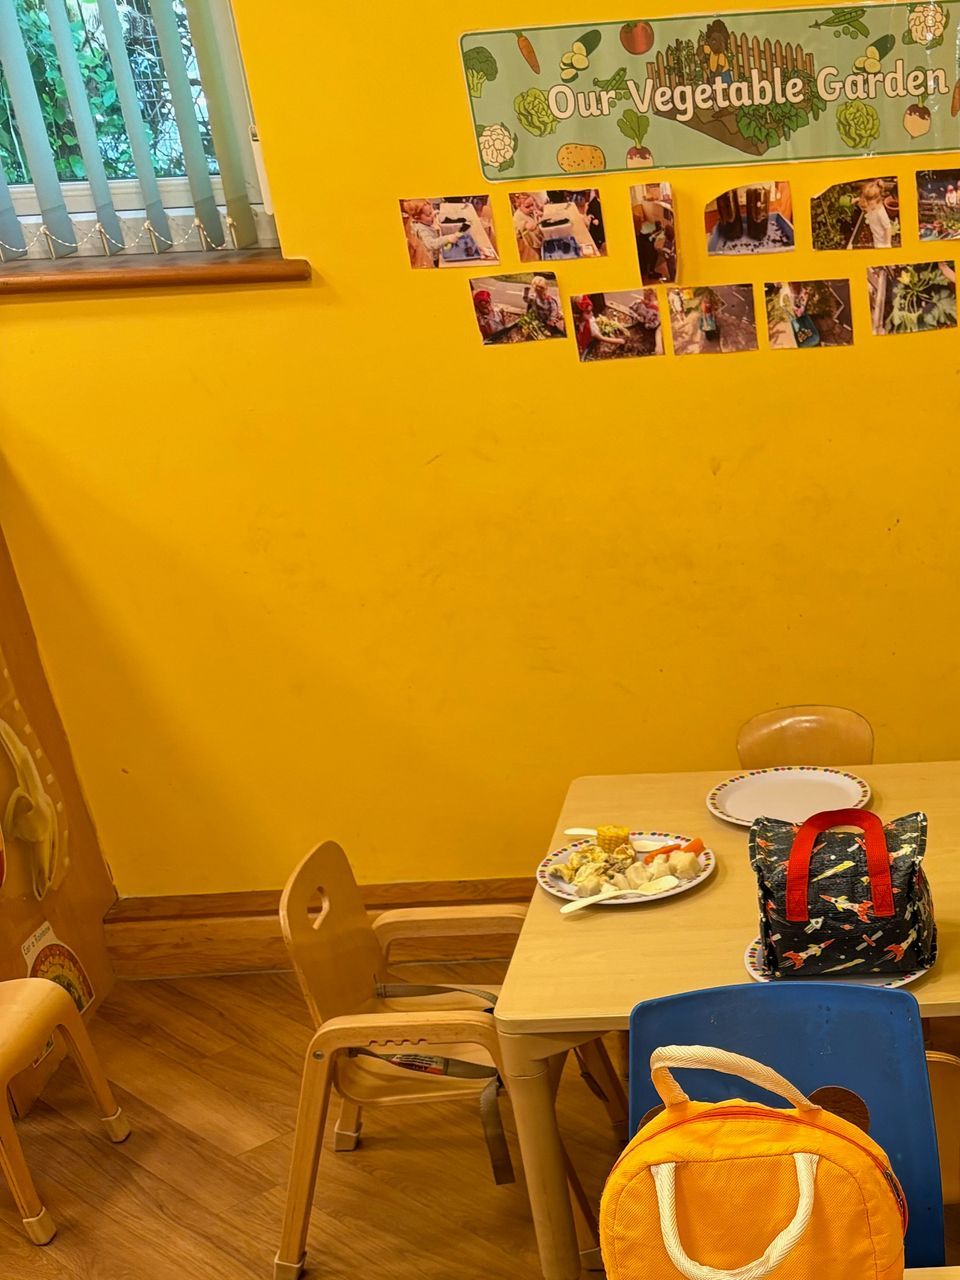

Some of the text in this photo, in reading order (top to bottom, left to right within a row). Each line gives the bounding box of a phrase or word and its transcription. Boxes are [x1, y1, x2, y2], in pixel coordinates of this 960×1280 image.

[547, 59, 949, 122] Our Vegetable Garden
